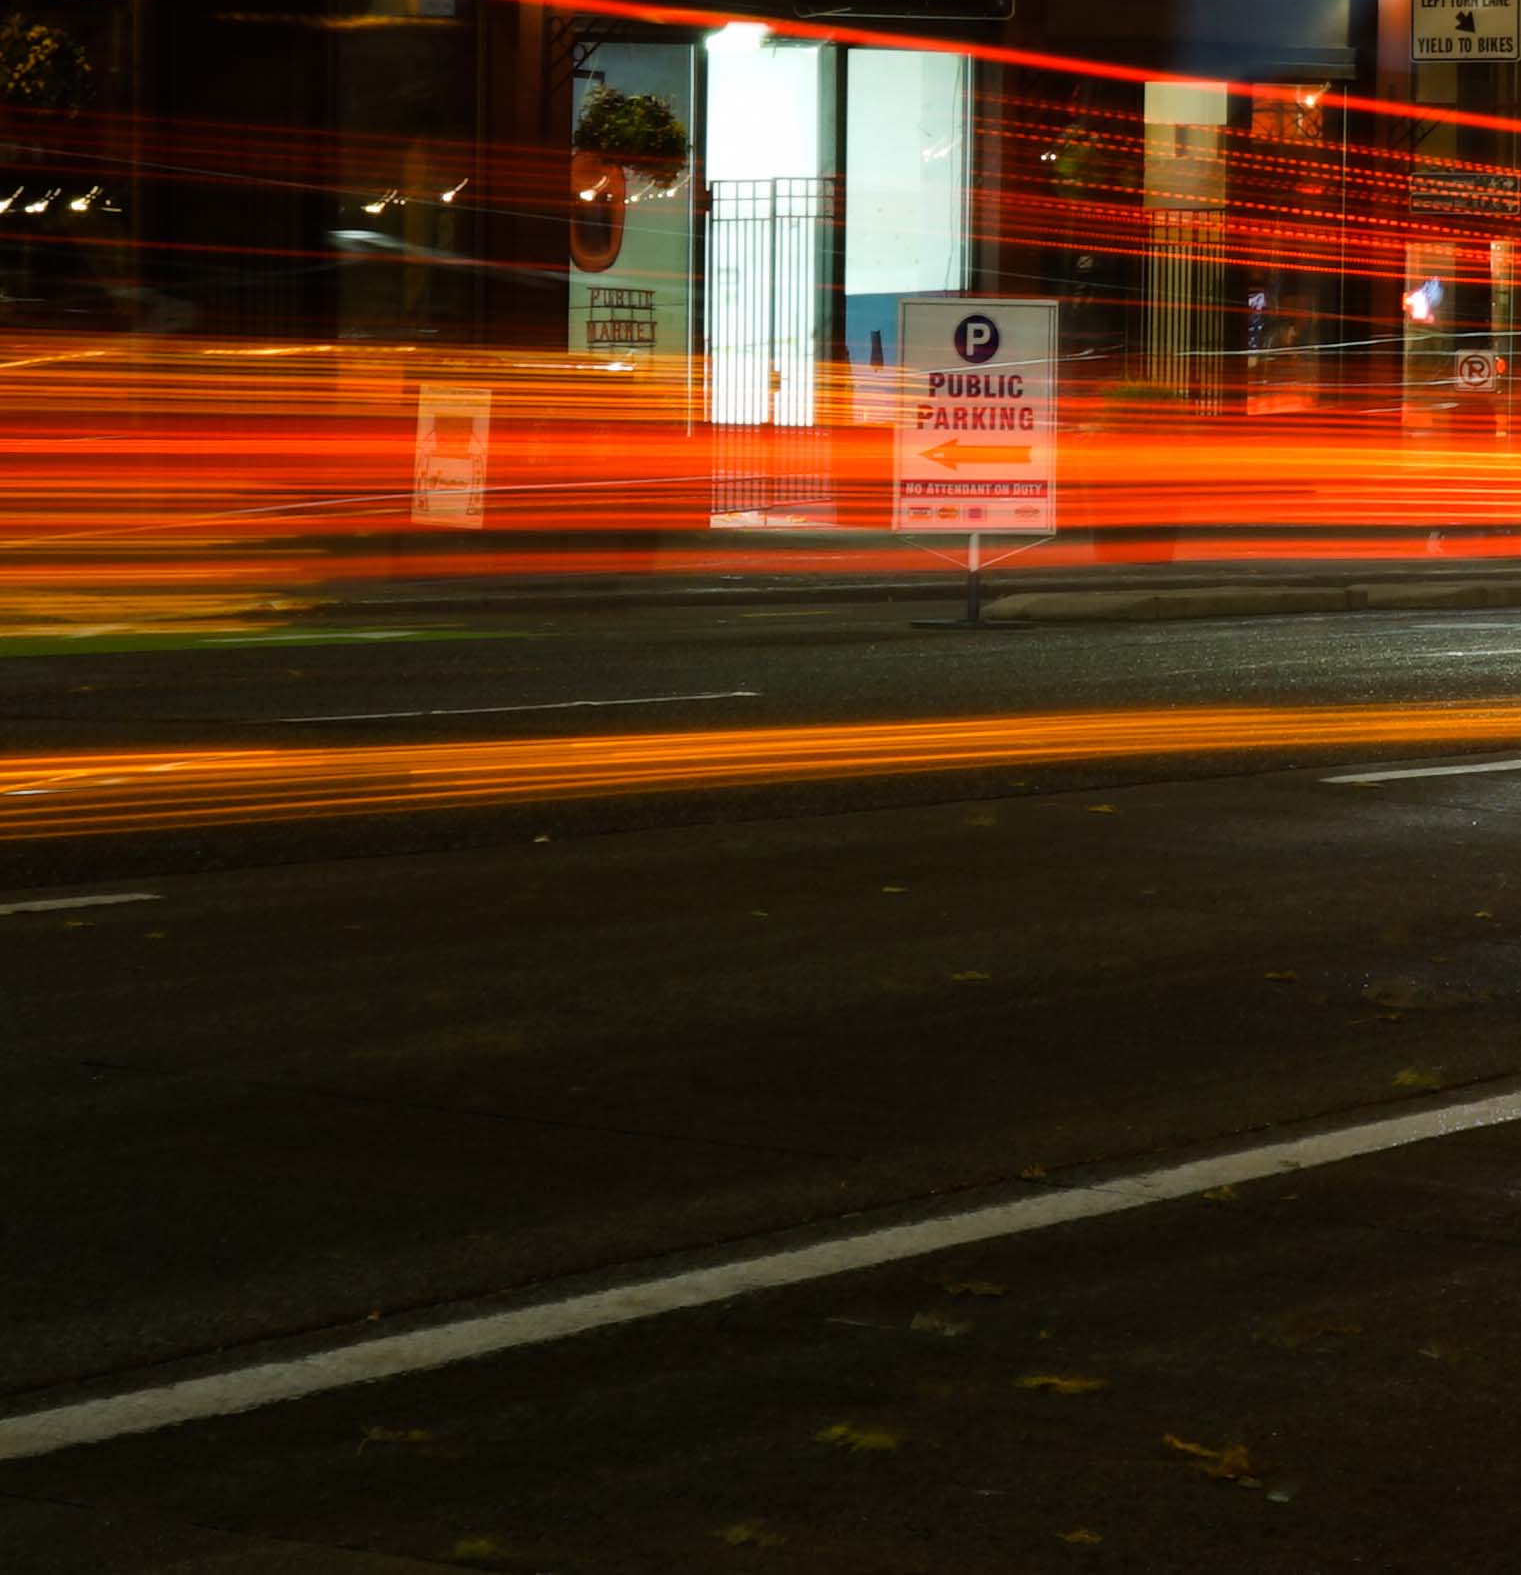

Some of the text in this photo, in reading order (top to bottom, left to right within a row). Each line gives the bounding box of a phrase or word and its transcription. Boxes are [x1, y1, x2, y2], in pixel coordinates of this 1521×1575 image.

[1418, 36, 1514, 53] YIELD TO BIKES
[966, 322, 991, 357] P
[928, 372, 1024, 398] PUBLIC
[917, 404, 1034, 431] PARKING
[906, 482, 1043, 496] NO ATTENDANT ON DUTY
